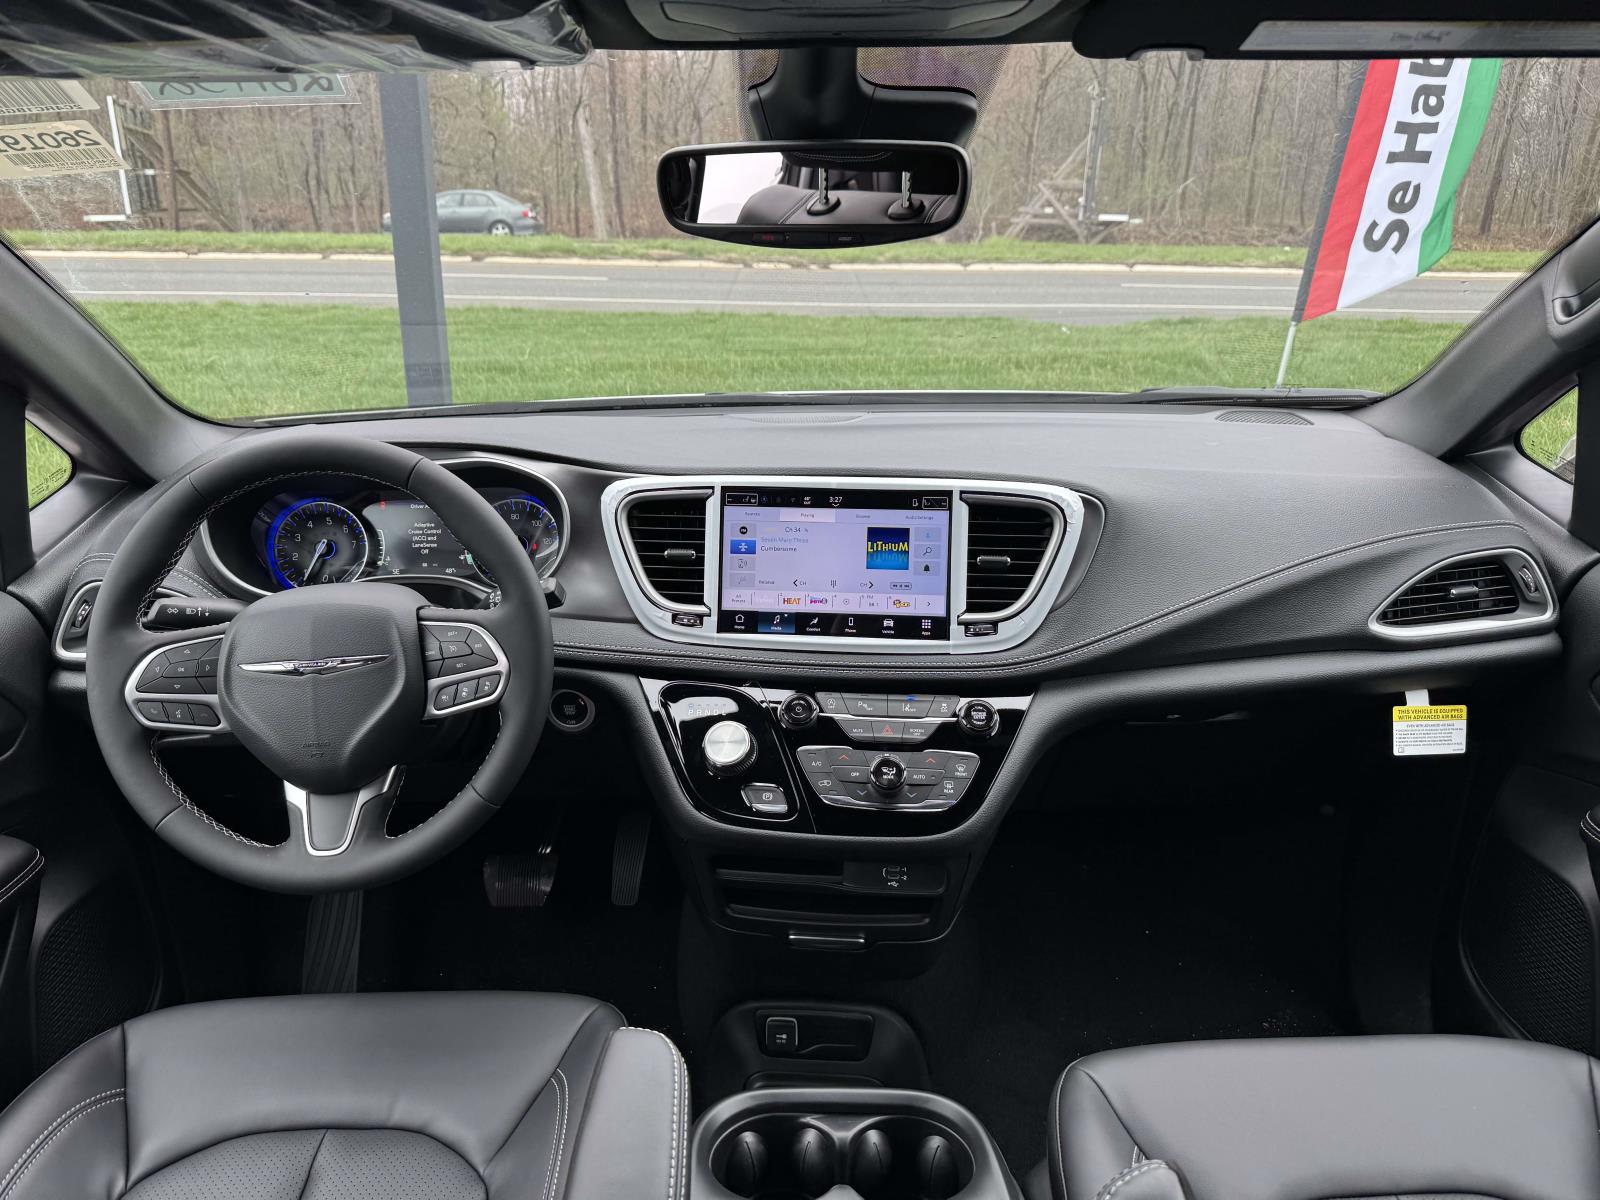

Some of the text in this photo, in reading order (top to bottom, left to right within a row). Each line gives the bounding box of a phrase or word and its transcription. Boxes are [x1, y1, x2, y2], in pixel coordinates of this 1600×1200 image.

[1363, 180, 1421, 254] Se
[307, 520, 313, 529] 4
[326, 517, 333, 526] 5
[295, 533, 301, 542] 3
[543, 537, 553, 545] 120
[351, 540, 357, 549] 7
[292, 552, 299, 561] 2
[322, 574, 329, 582] 0
